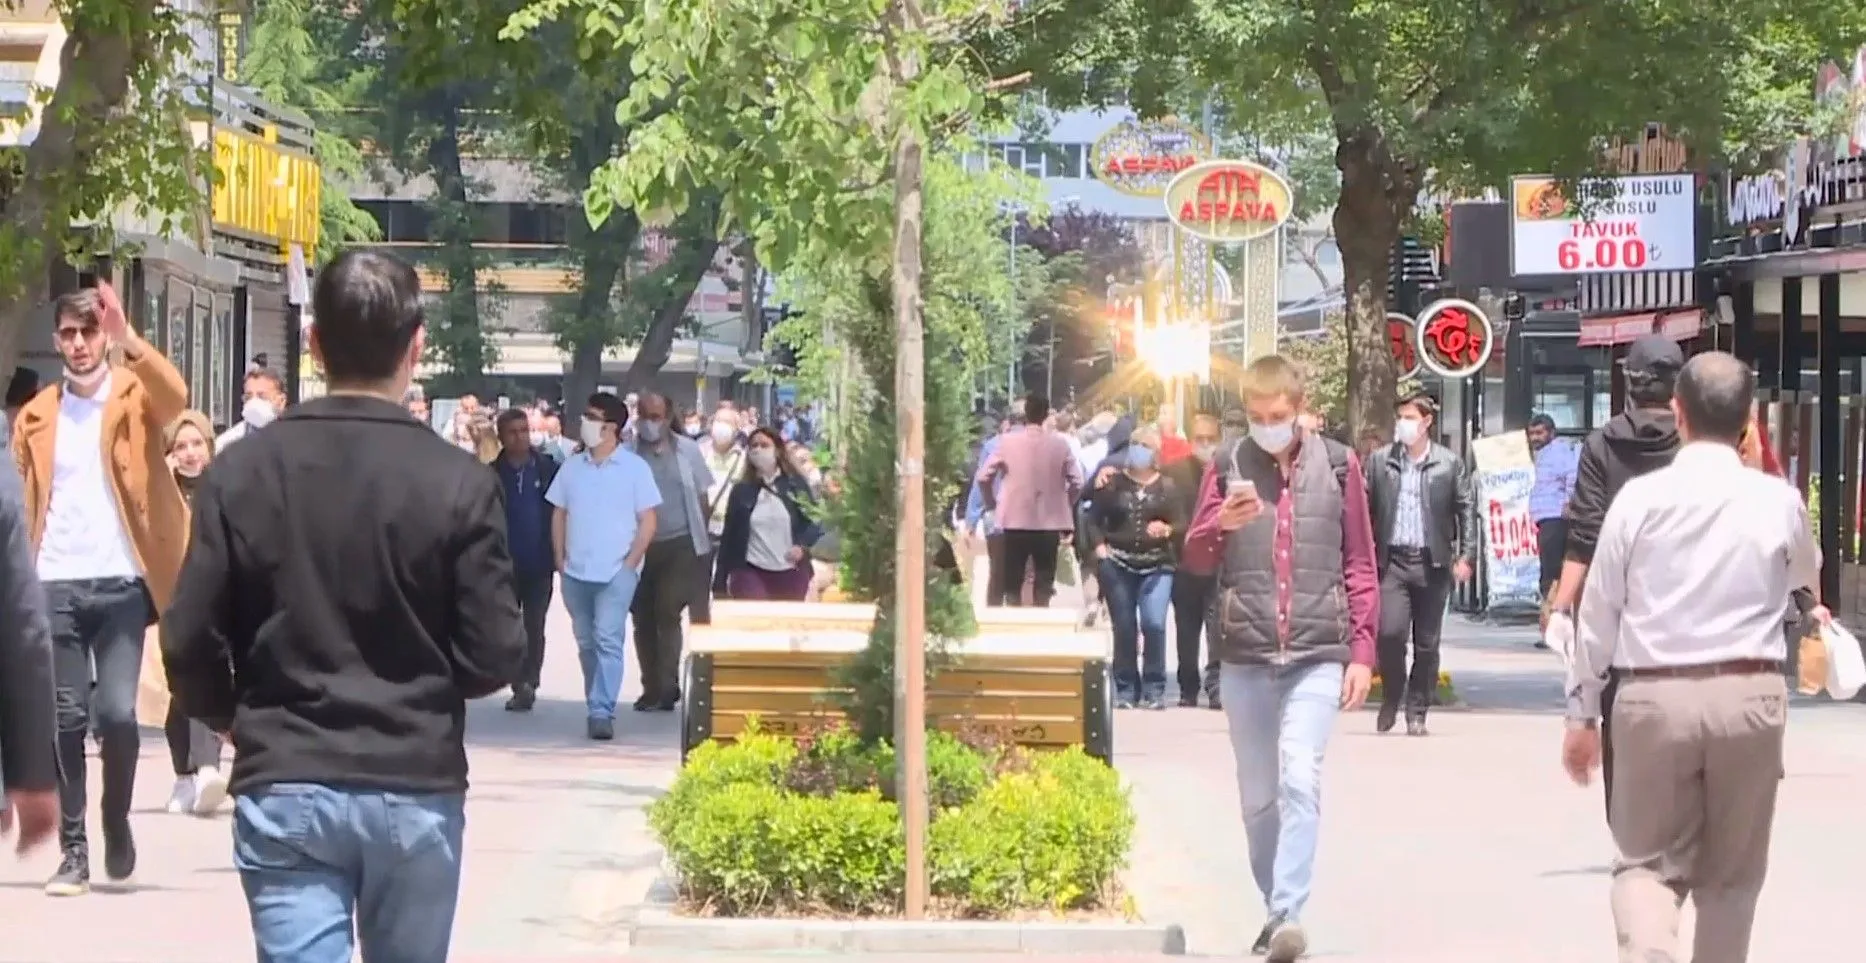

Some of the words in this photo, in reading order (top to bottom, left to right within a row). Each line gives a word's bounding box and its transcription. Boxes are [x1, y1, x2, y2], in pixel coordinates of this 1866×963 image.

[1180, 201, 1277, 221] ASPAVA
[1571, 222, 1638, 238] TAVUK
[1558, 239, 1646, 270] 6.00
